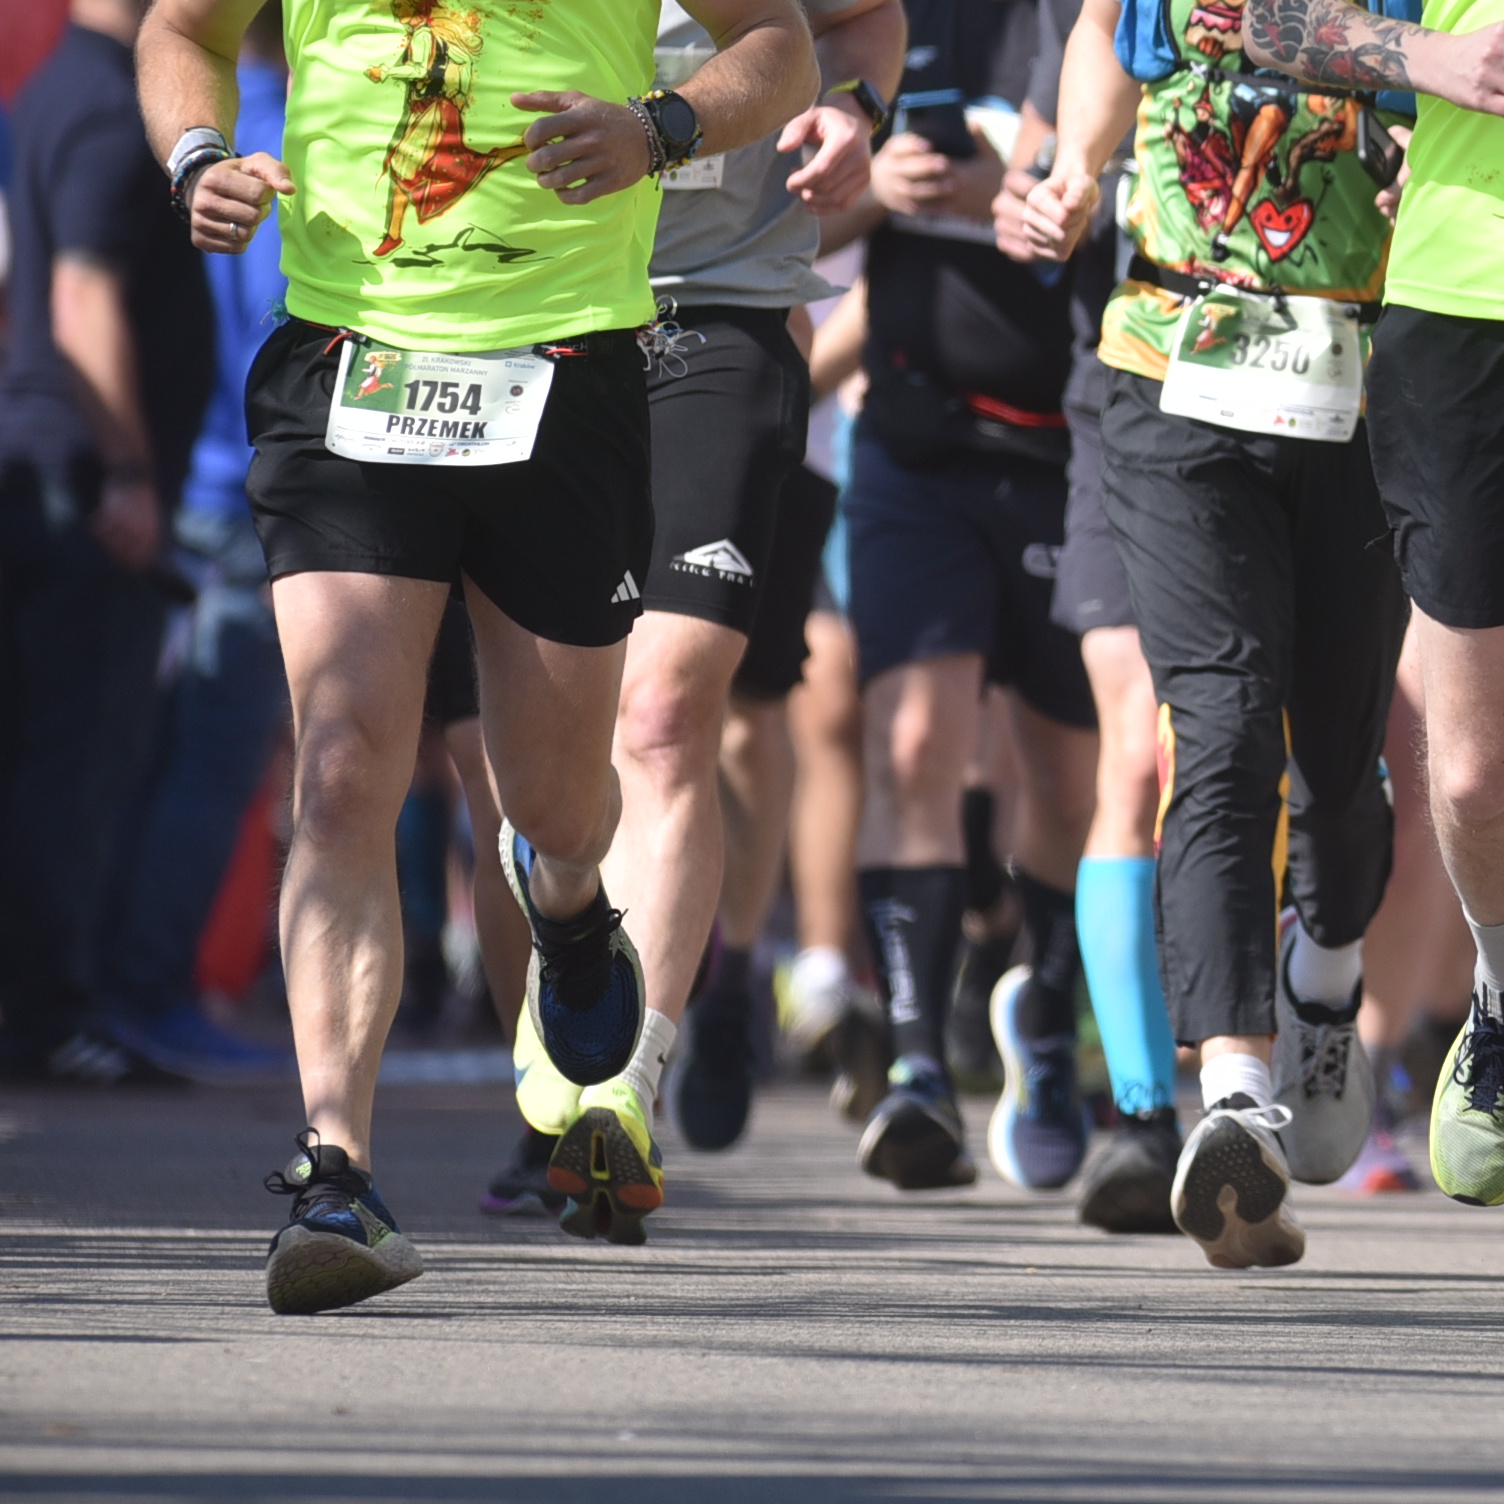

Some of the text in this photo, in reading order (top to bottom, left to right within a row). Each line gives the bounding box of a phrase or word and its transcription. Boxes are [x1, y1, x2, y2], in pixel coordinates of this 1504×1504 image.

[1230, 332, 1310, 375] 3250
[404, 379, 483, 416] 1754
[386, 415, 488, 439] PRZEMEK
